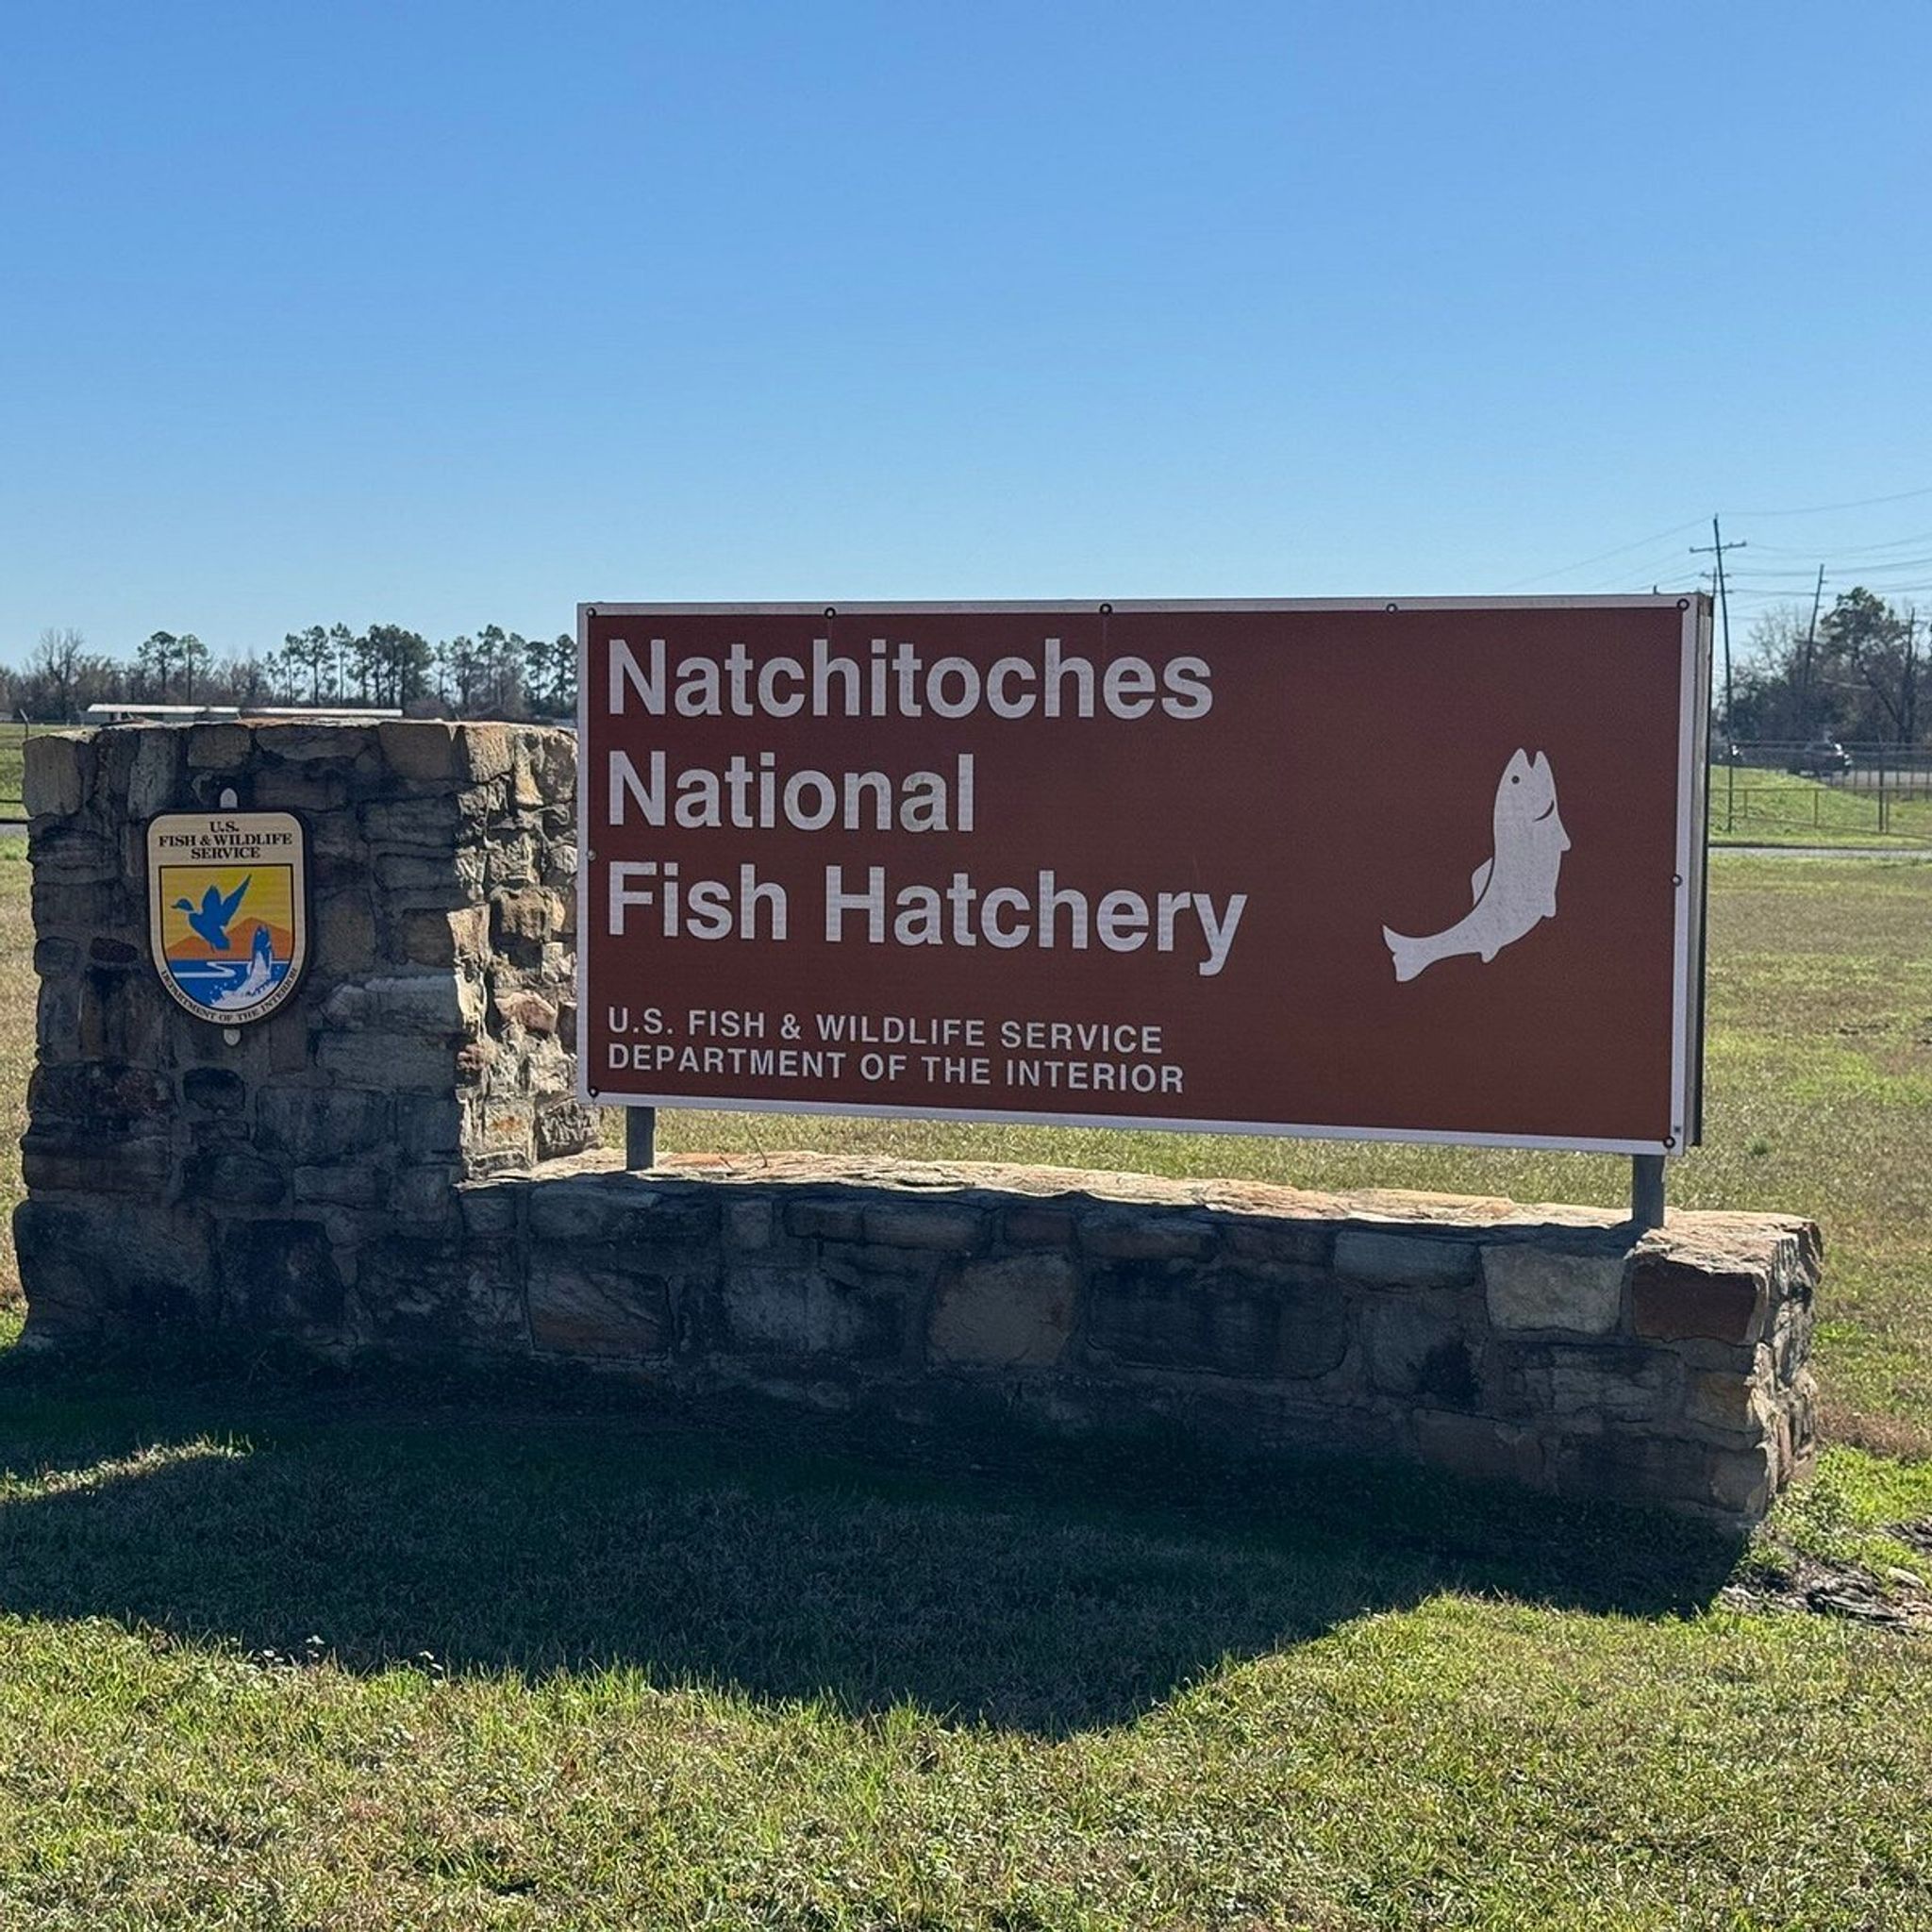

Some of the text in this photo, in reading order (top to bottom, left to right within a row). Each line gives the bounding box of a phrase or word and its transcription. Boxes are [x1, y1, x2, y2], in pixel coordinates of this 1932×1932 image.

[610, 639, 1212, 719] Natchitoches
[610, 751, 973, 831] National
[158, 833, 292, 847] FISH & WILDLIFE
[209, 821, 240, 833] U.S.
[191, 846, 260, 859] SERVICE
[609, 861, 1247, 975] Fish Hatchery
[160, 967, 298, 1023] DEPARTMENT OF THE INTERIOR
[609, 1008, 1161, 1053] U.S. FISH & WILDLIFE SERVICE
[609, 1043, 1183, 1092] DEPARTMENT OF THE INTERIOR
